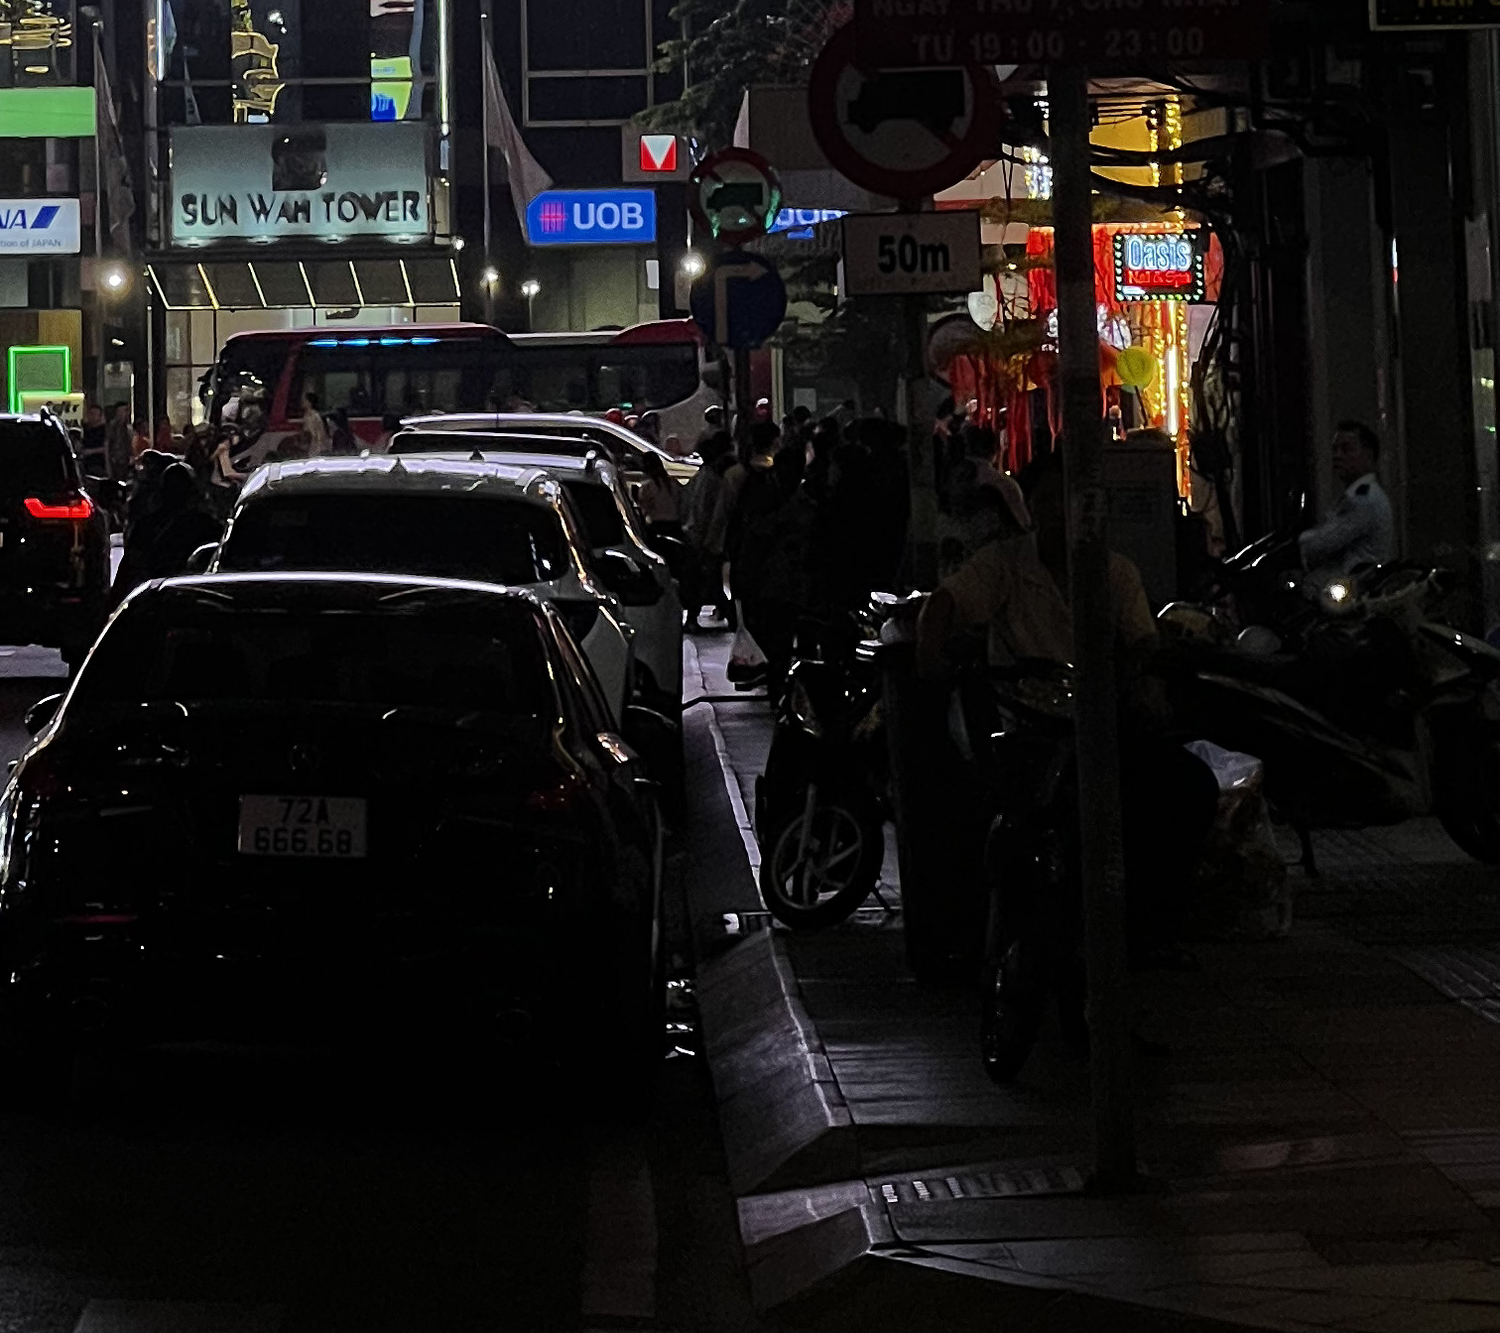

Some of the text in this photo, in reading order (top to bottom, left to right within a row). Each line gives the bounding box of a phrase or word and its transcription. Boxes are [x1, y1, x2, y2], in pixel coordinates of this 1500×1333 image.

[180, 191, 420, 226] SUN WAH TOWER
[572, 202, 644, 230] UOB
[20, 238, 29, 247] of
[31, 238, 62, 247] JAPAN
[878, 235, 949, 274] 50m
[1126, 236, 1192, 271] Oasis
[279, 798, 329, 823] 72A
